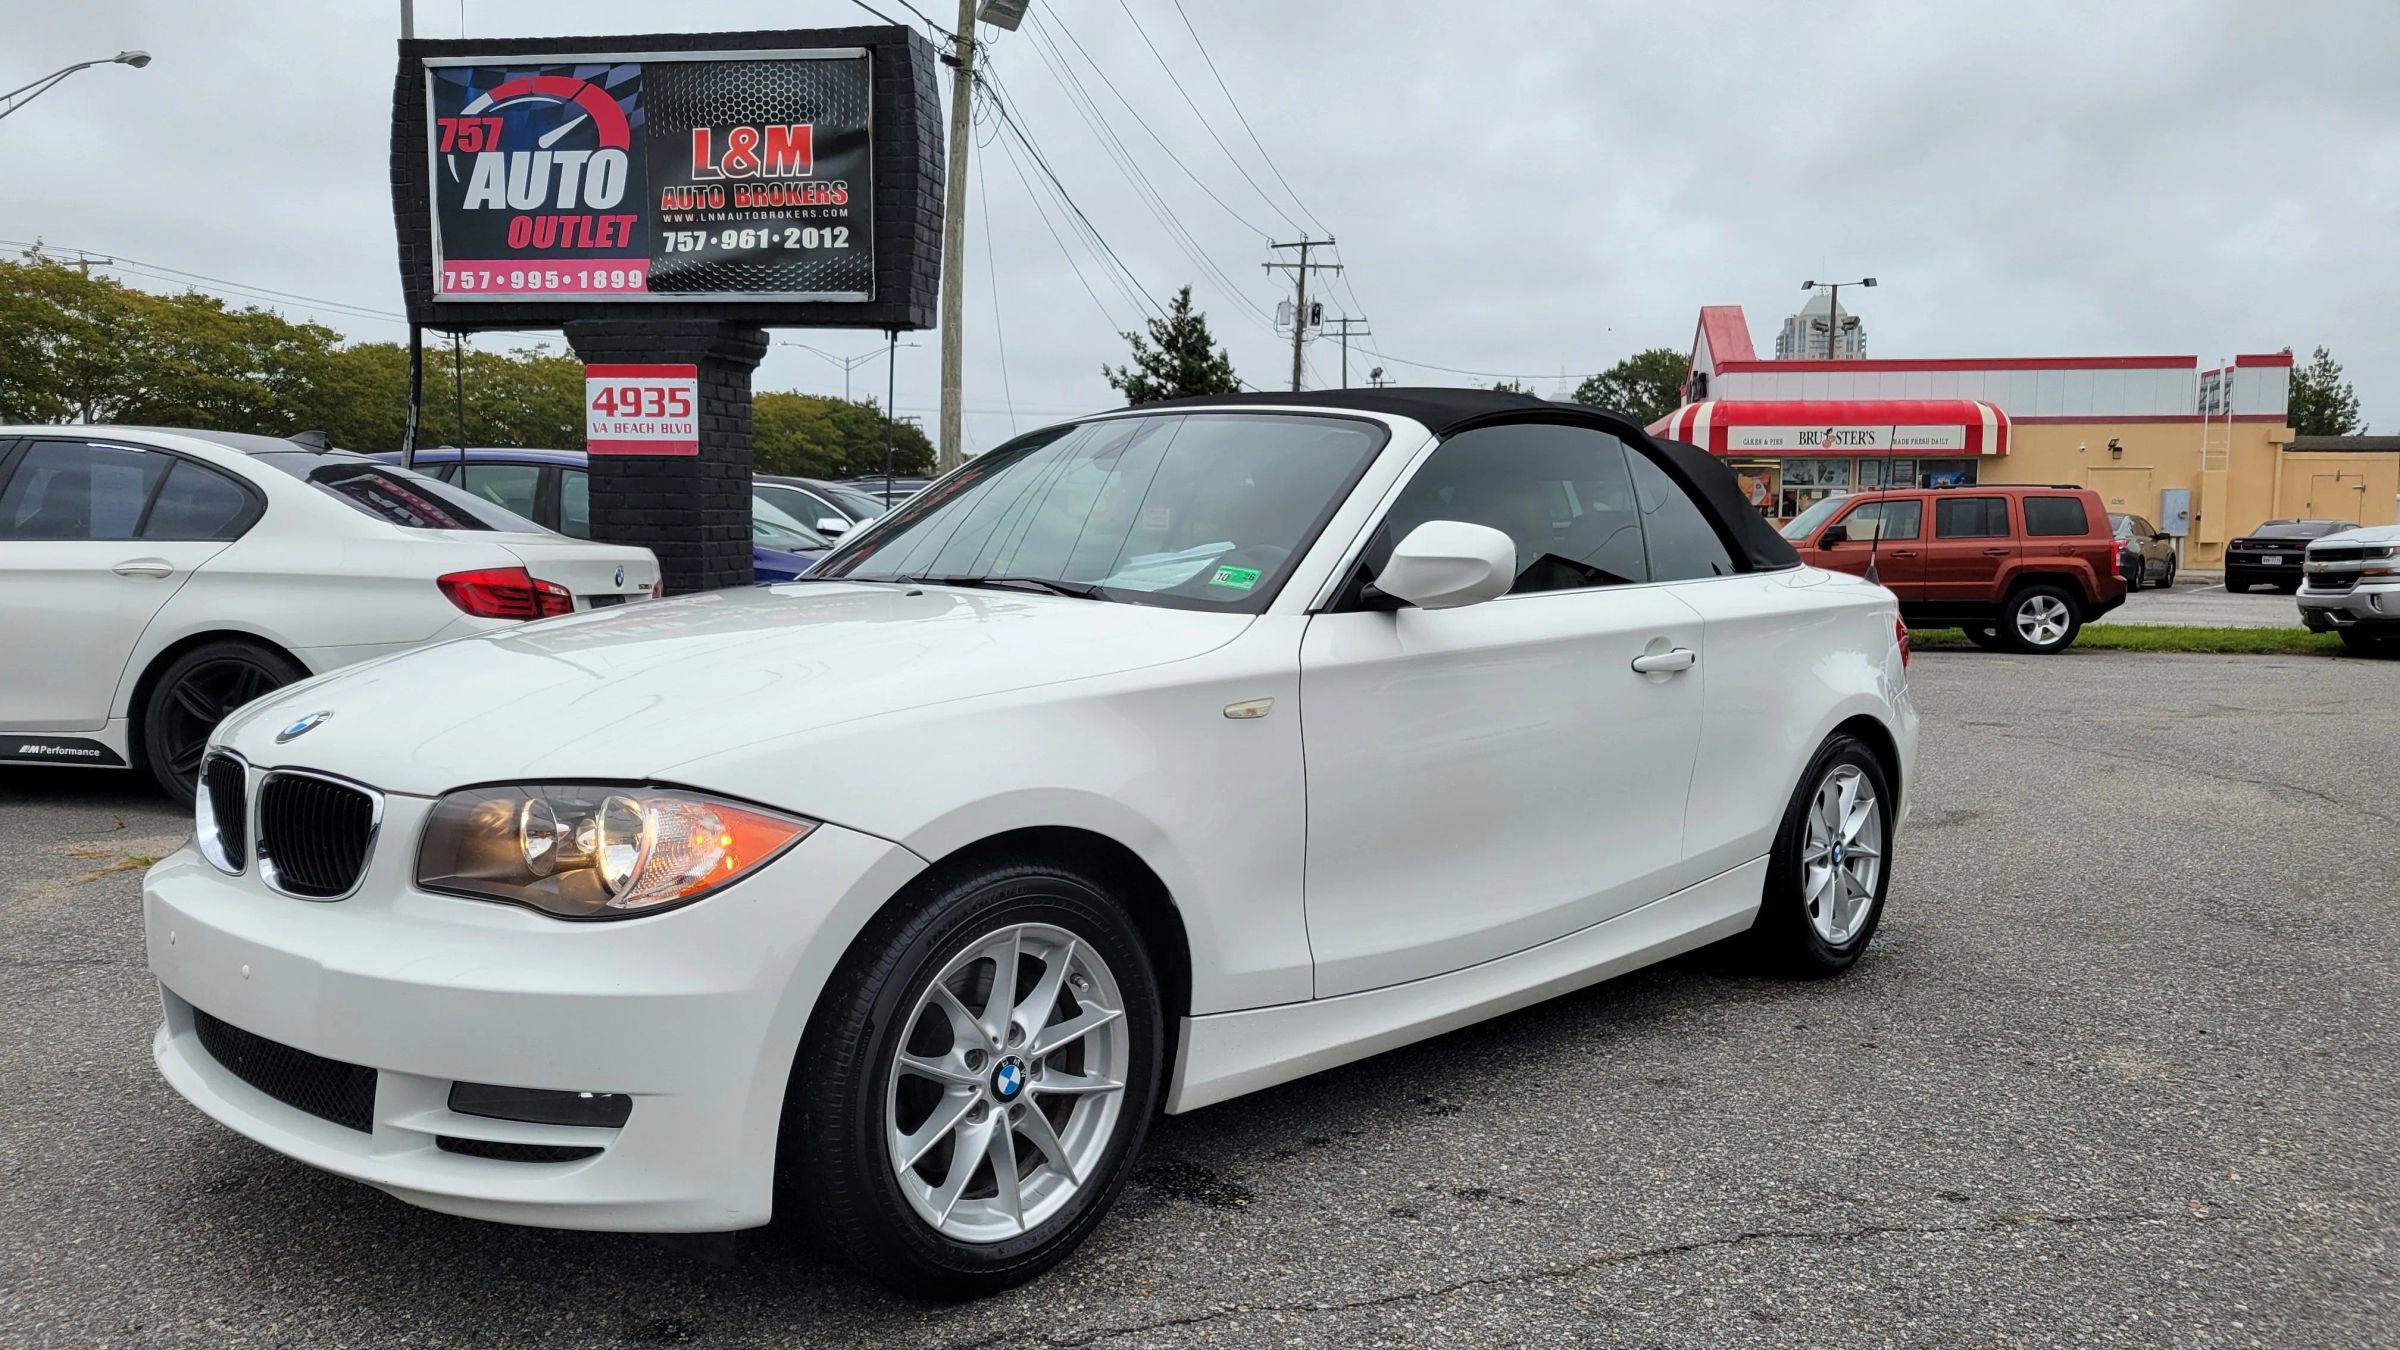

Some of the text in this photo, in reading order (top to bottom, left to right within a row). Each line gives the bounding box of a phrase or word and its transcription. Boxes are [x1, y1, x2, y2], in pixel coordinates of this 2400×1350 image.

[437, 117, 504, 153] 757
[691, 124, 813, 180] L&M
[462, 149, 628, 210] AUTO
[661, 180, 849, 211] AUTO BROKERS
[663, 209, 849, 223] WWW.LNMAUTOBROKERS.COM
[507, 215, 638, 249] OUTLET
[592, 387, 691, 418] 4935
[592, 423, 692, 434] VA BEACH BLVD
[1742, 438, 1784, 446] CAKES & PIES
[1911, 438, 1930, 446] FRESH
[1931, 438, 1949, 446] DAILY
[1217, 573, 1230, 581] 10
[40, 746, 100, 757] Performance
[1000, 1056, 1027, 1078] BMW
